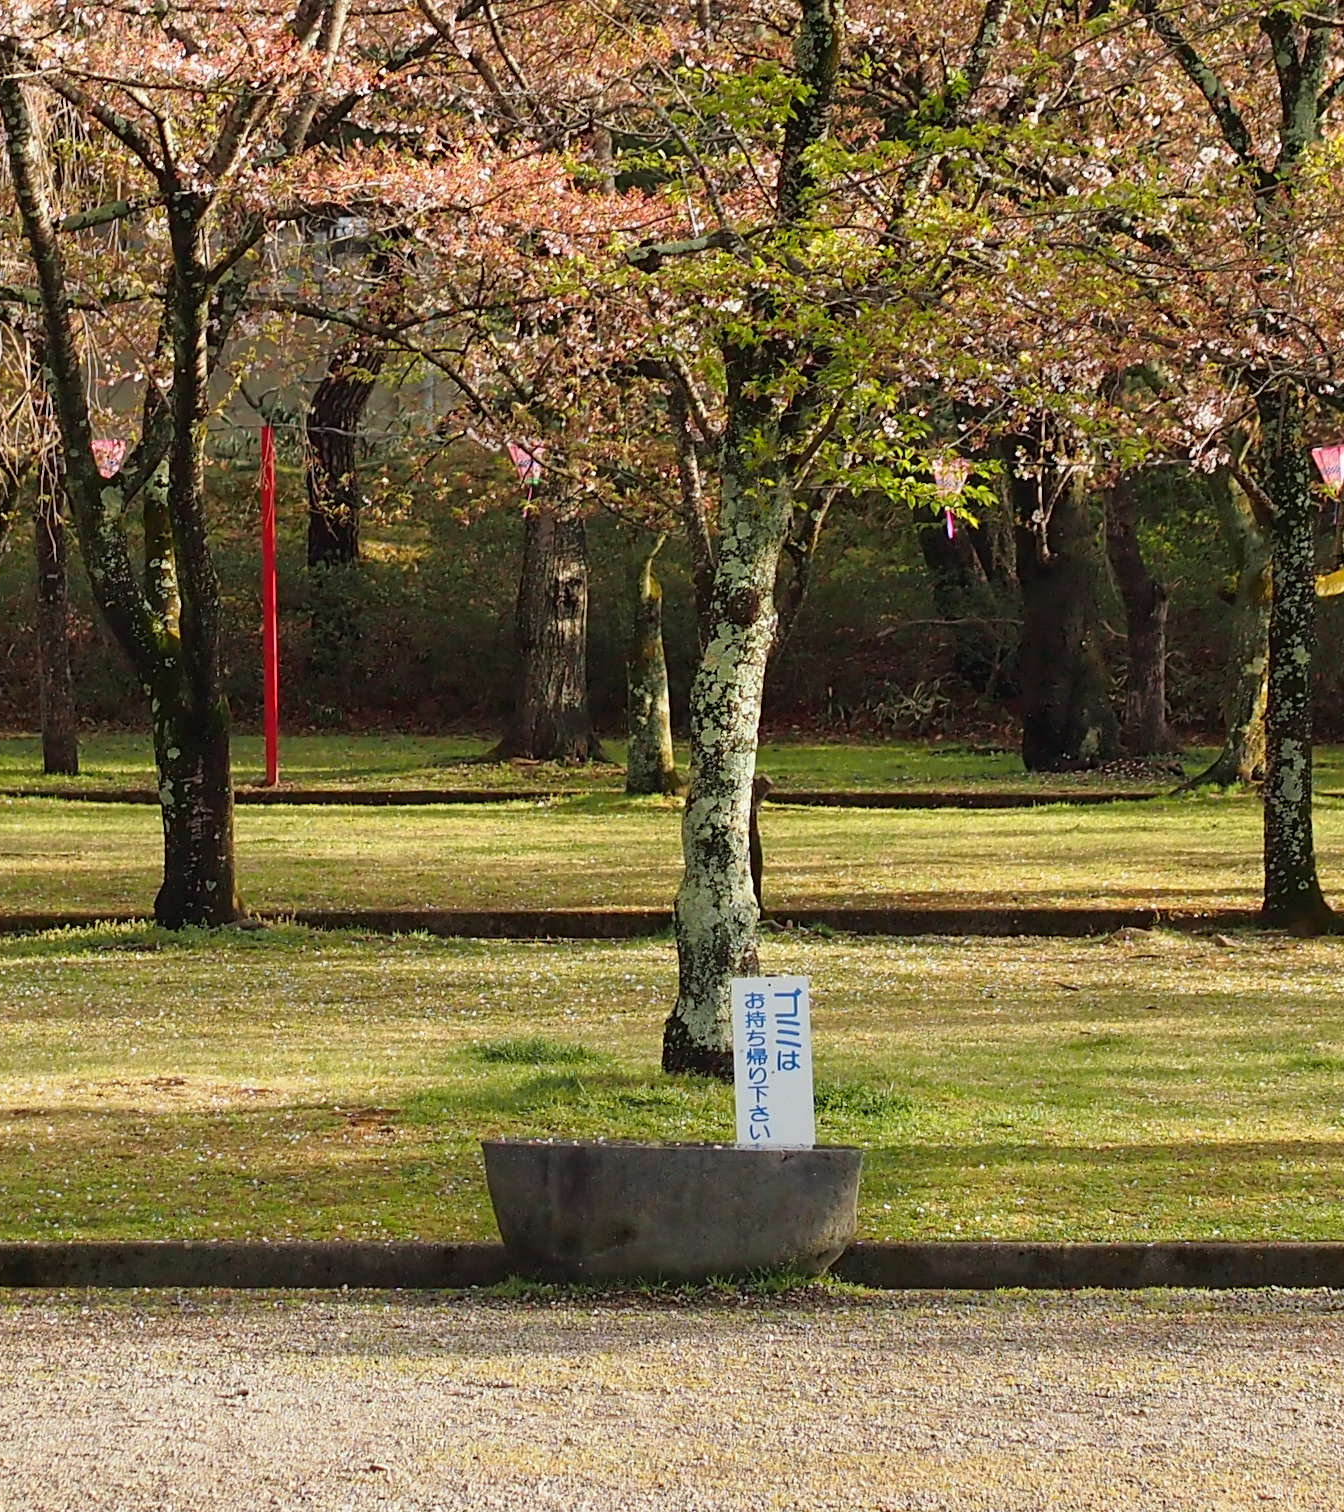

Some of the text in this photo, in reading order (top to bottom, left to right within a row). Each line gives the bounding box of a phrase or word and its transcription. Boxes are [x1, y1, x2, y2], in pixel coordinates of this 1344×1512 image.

[745, 992, 772, 1140] お持ち帰り下さい
[774, 988, 802, 1072] ゴミは
